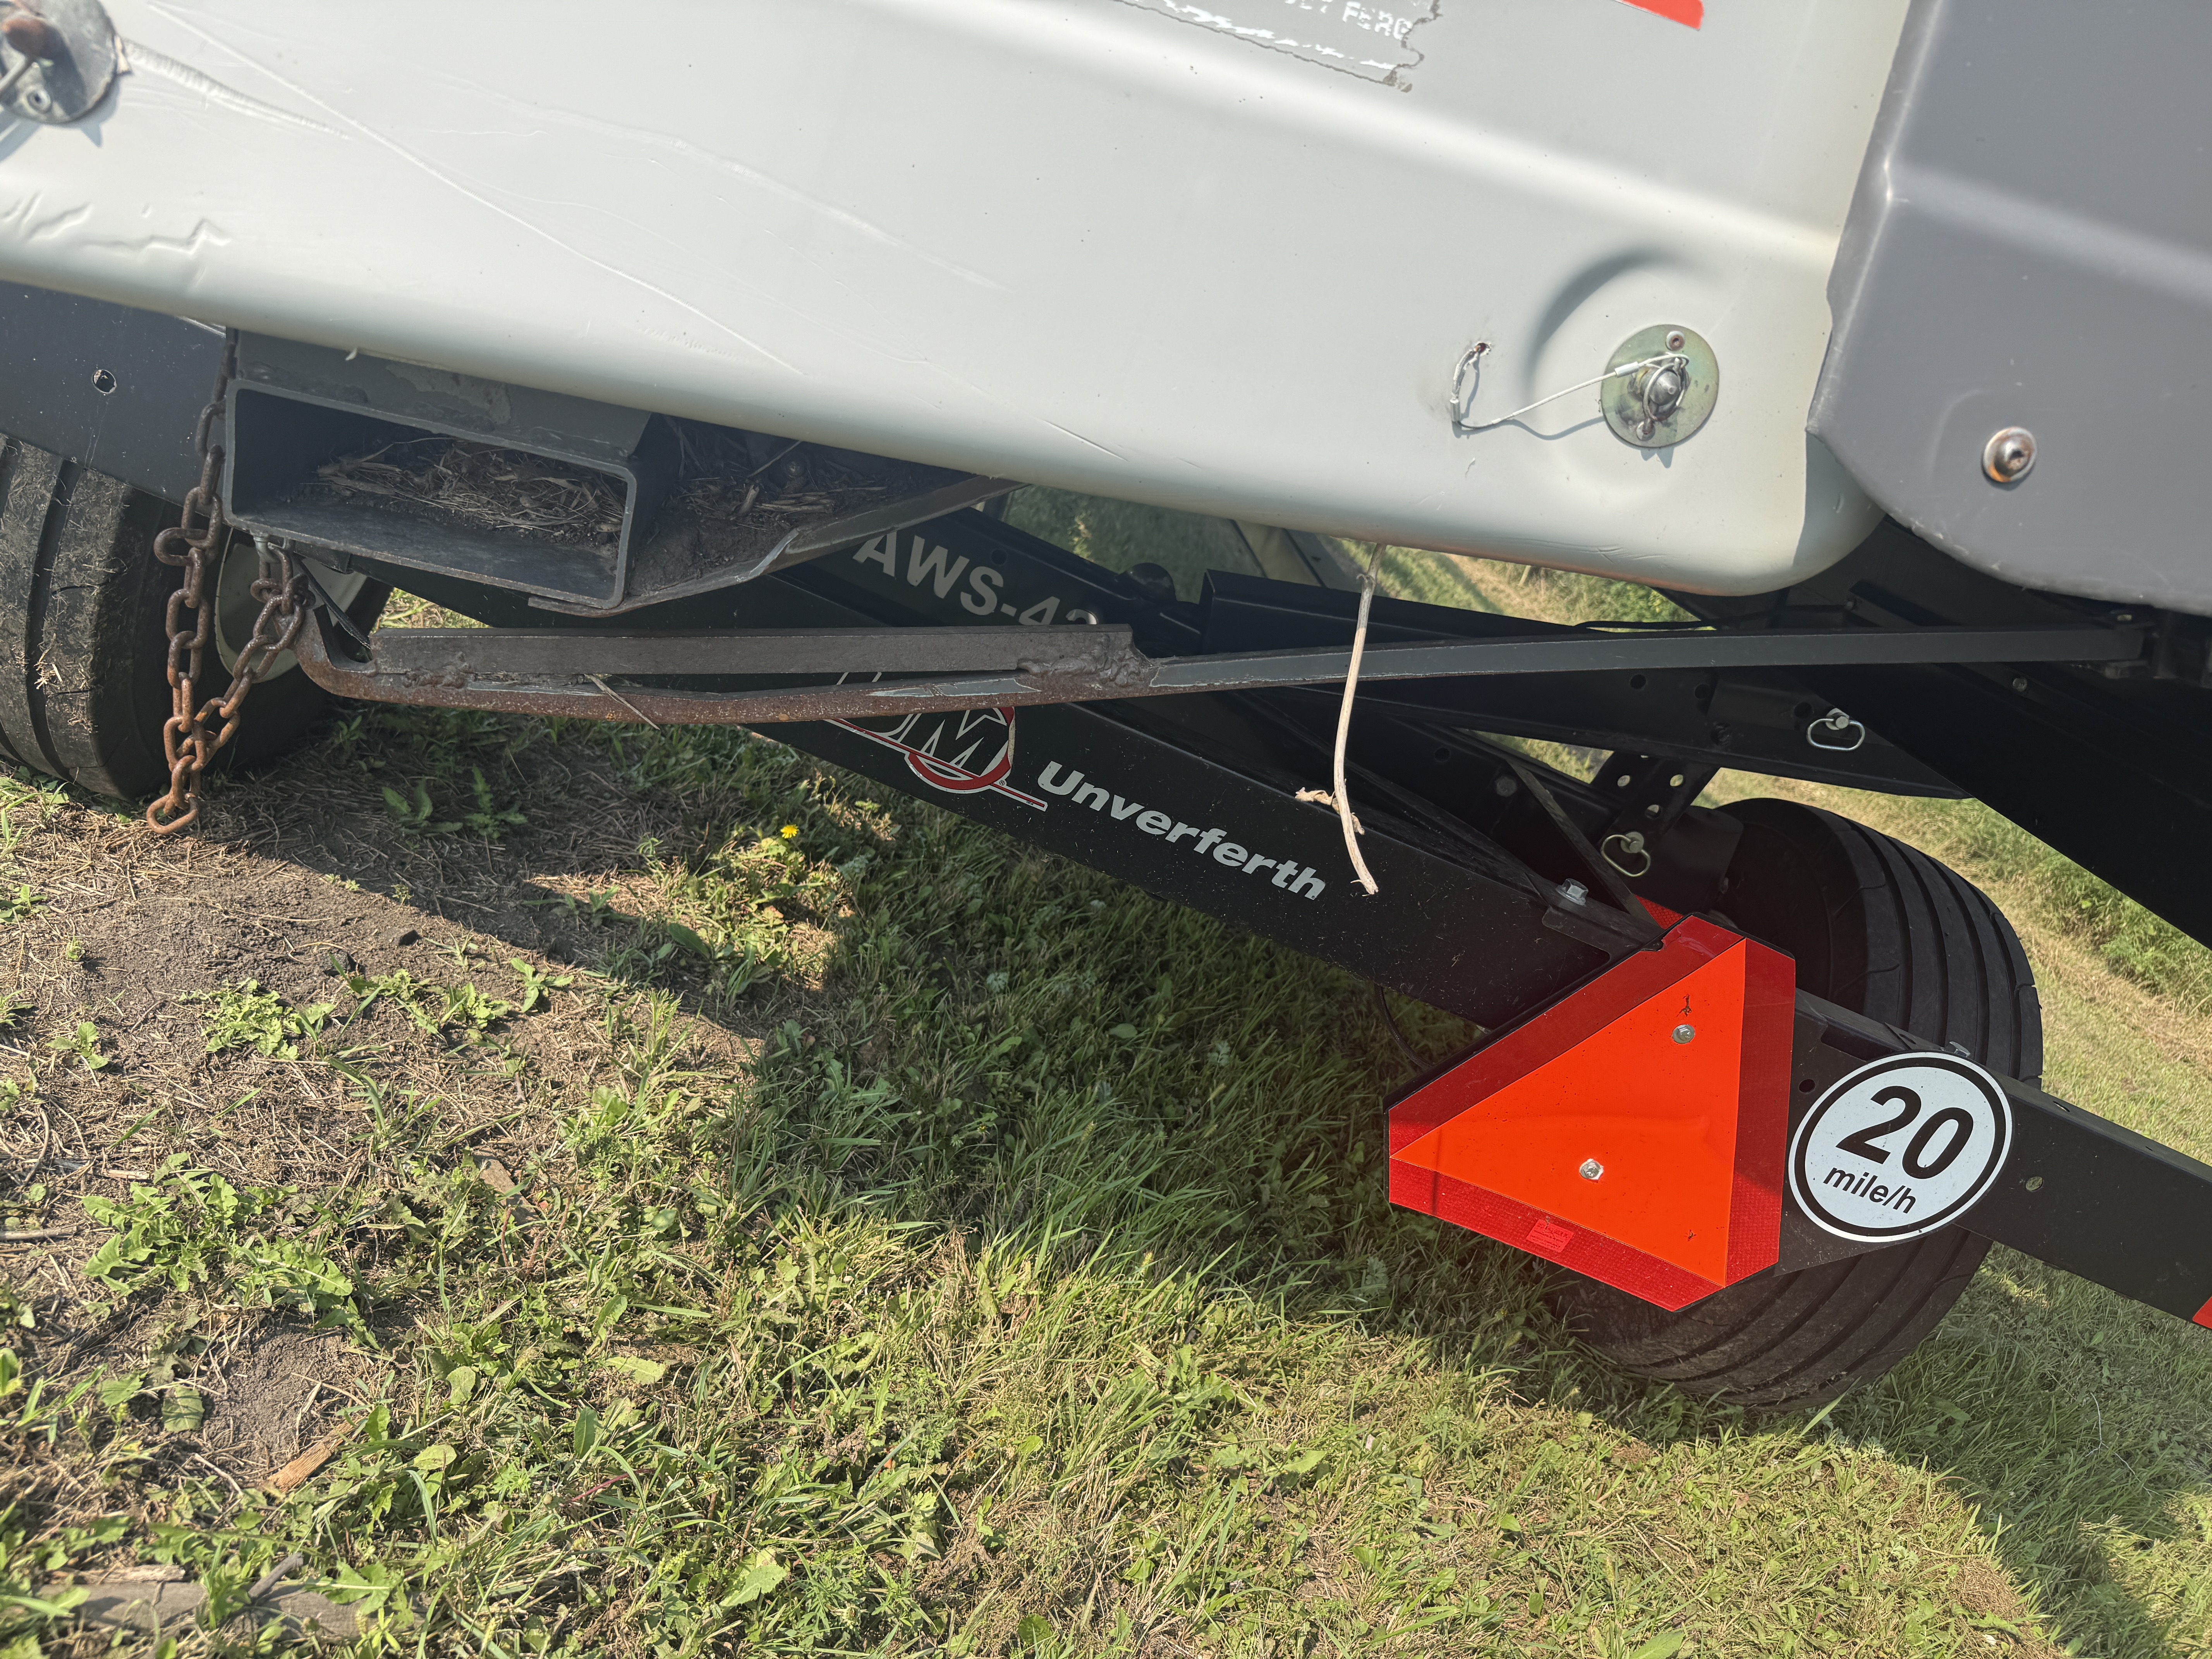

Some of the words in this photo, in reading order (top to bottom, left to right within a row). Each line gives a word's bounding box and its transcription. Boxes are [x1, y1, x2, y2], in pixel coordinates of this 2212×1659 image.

[1037, 761, 1326, 900] Unverferth
[1835, 1085, 1974, 1179] 20
[1823, 1167, 1917, 1214] mile/h
